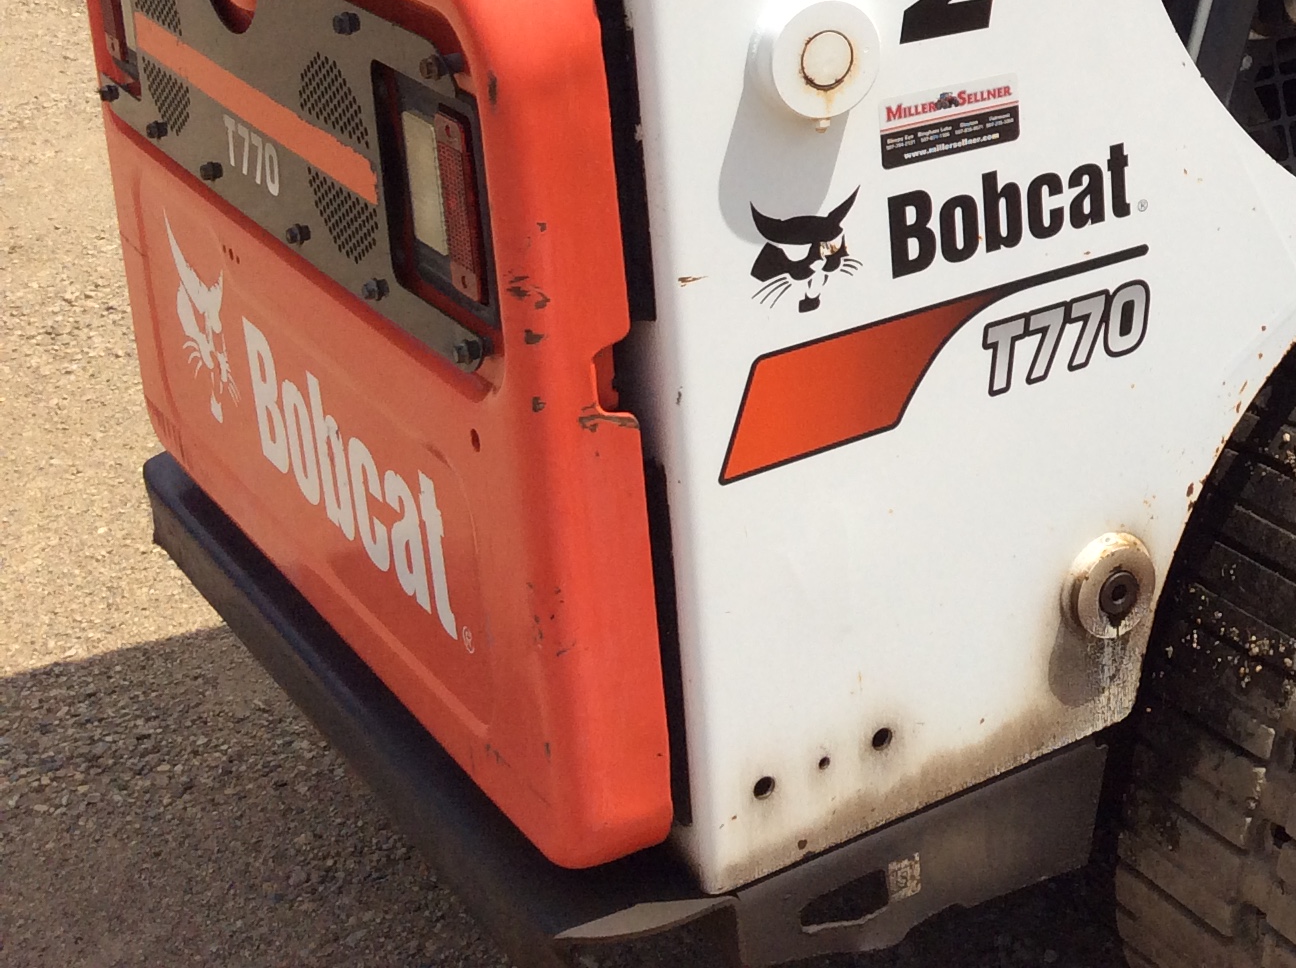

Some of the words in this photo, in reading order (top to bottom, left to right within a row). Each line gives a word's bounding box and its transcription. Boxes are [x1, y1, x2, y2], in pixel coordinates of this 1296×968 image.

[222, 115, 280, 197] T770
[885, 102, 938, 123] MILLER
[957, 85, 1013, 107] SELLNER
[887, 142, 1132, 279] Bobcat
[982, 279, 1150, 397] T770
[241, 315, 457, 640] Bobcat
